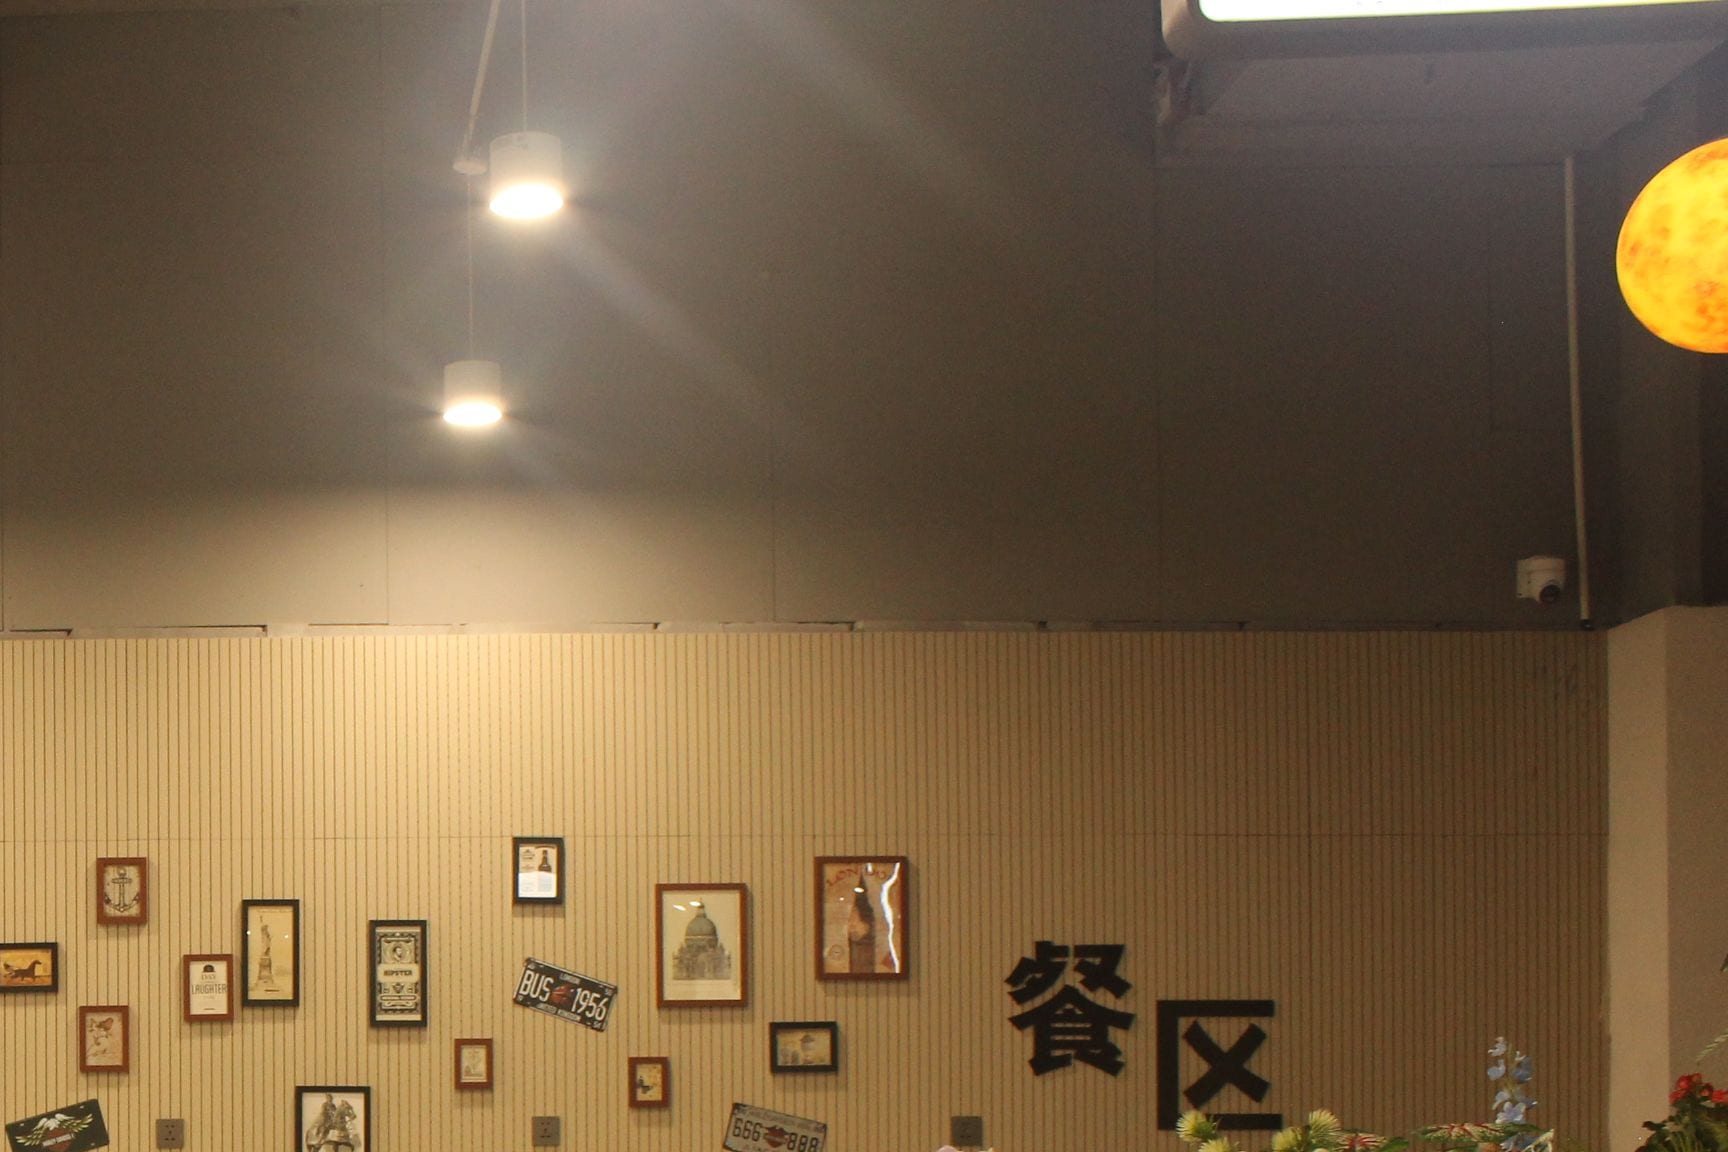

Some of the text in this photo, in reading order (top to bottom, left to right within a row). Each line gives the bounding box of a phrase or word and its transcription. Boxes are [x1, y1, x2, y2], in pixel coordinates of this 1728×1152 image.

[191, 983, 227, 995] LAUGHTER
[519, 970, 609, 1021] BUS 1956
[1004, 940, 1284, 1132] 餐区
[733, 1118, 762, 1142] 666
